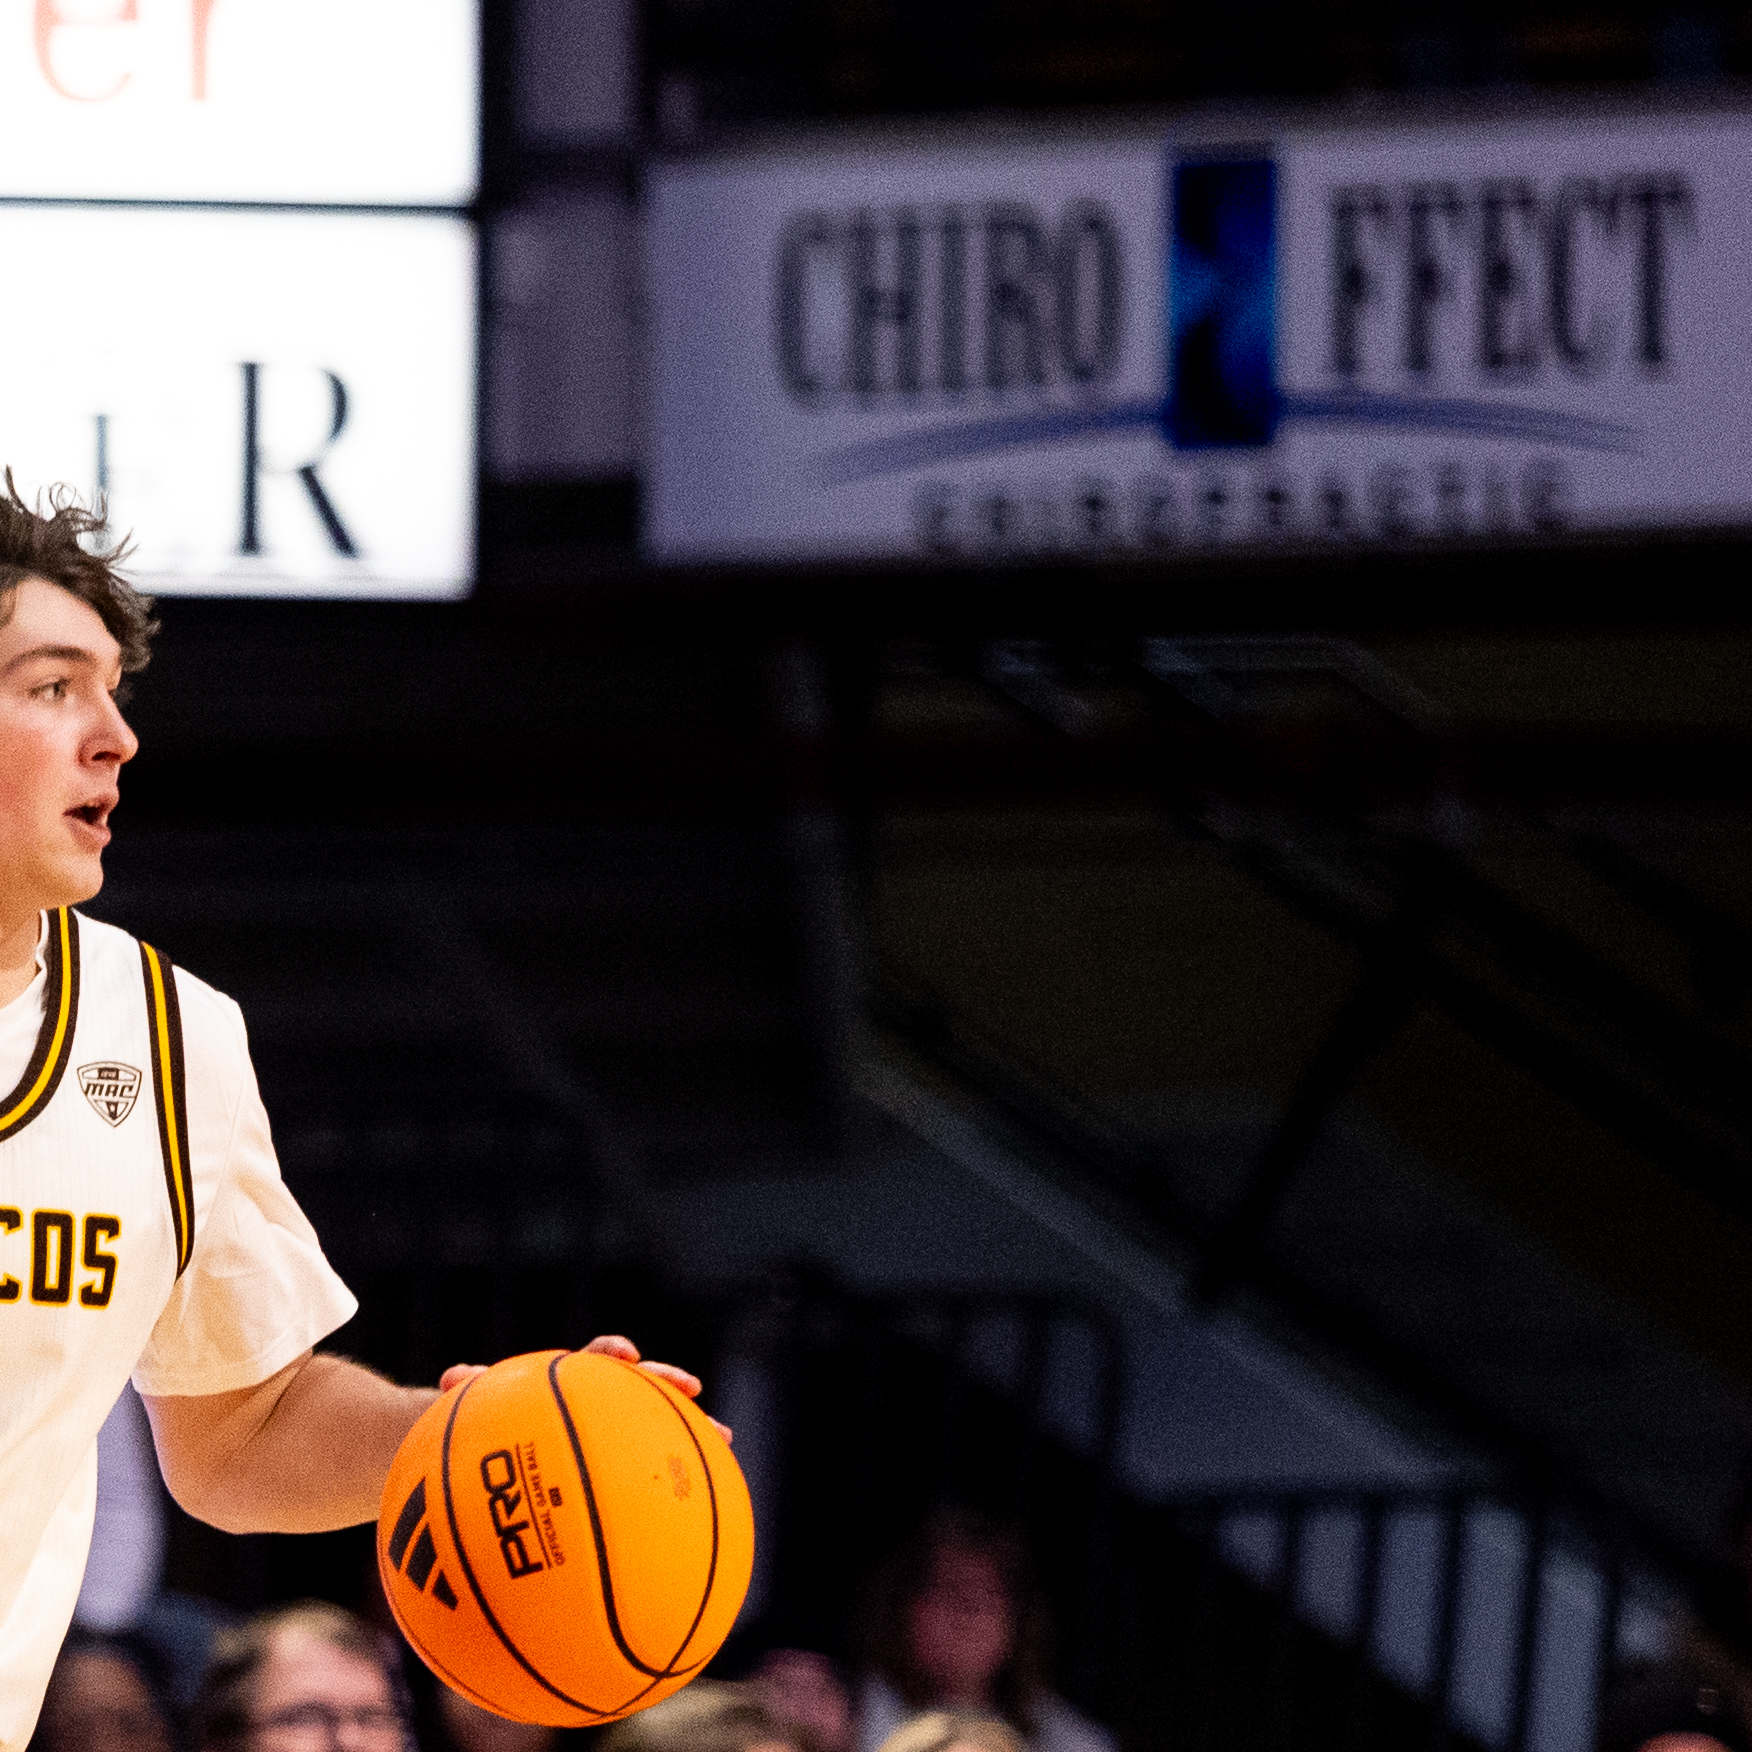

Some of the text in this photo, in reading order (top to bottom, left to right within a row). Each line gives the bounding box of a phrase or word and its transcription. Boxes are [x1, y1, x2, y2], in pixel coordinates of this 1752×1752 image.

[772, 198, 1125, 409] CHIRO
[84, 1083, 136, 1098] MAC
[522, 1441, 539, 1471] BALL
[530, 1473, 547, 1508] GAME
[480, 1449, 544, 1580] PRO
